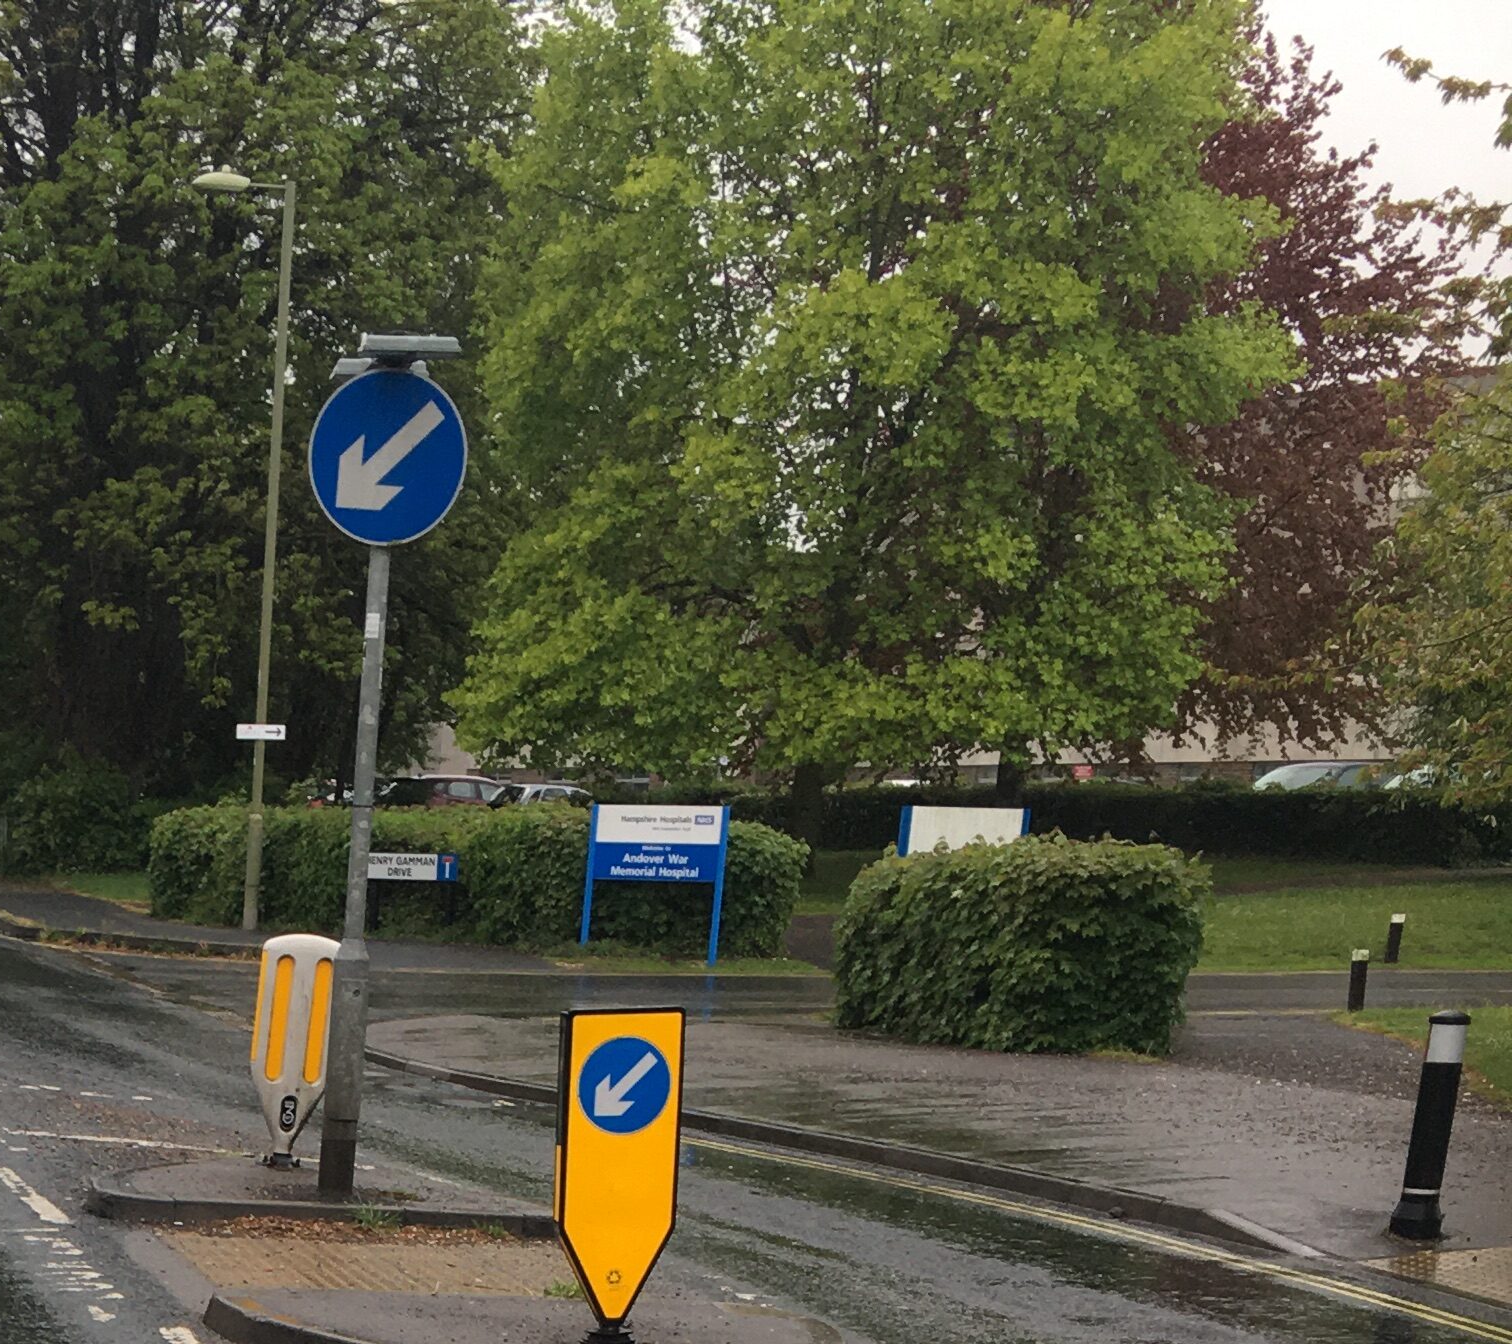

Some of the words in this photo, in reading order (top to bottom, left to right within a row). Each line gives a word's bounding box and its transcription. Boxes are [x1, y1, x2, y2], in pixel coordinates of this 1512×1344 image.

[621, 815, 657, 823] Hampshire
[660, 816, 692, 825] Hospitals
[696, 816, 714, 824] NHS
[396, 857, 436, 866] GAMMAN
[622, 853, 664, 864] Andover
[668, 854, 689, 865] War
[387, 867, 413, 877] DRIVE
[610, 866, 656, 876] Memorial
[658, 867, 700, 879] Hospital
